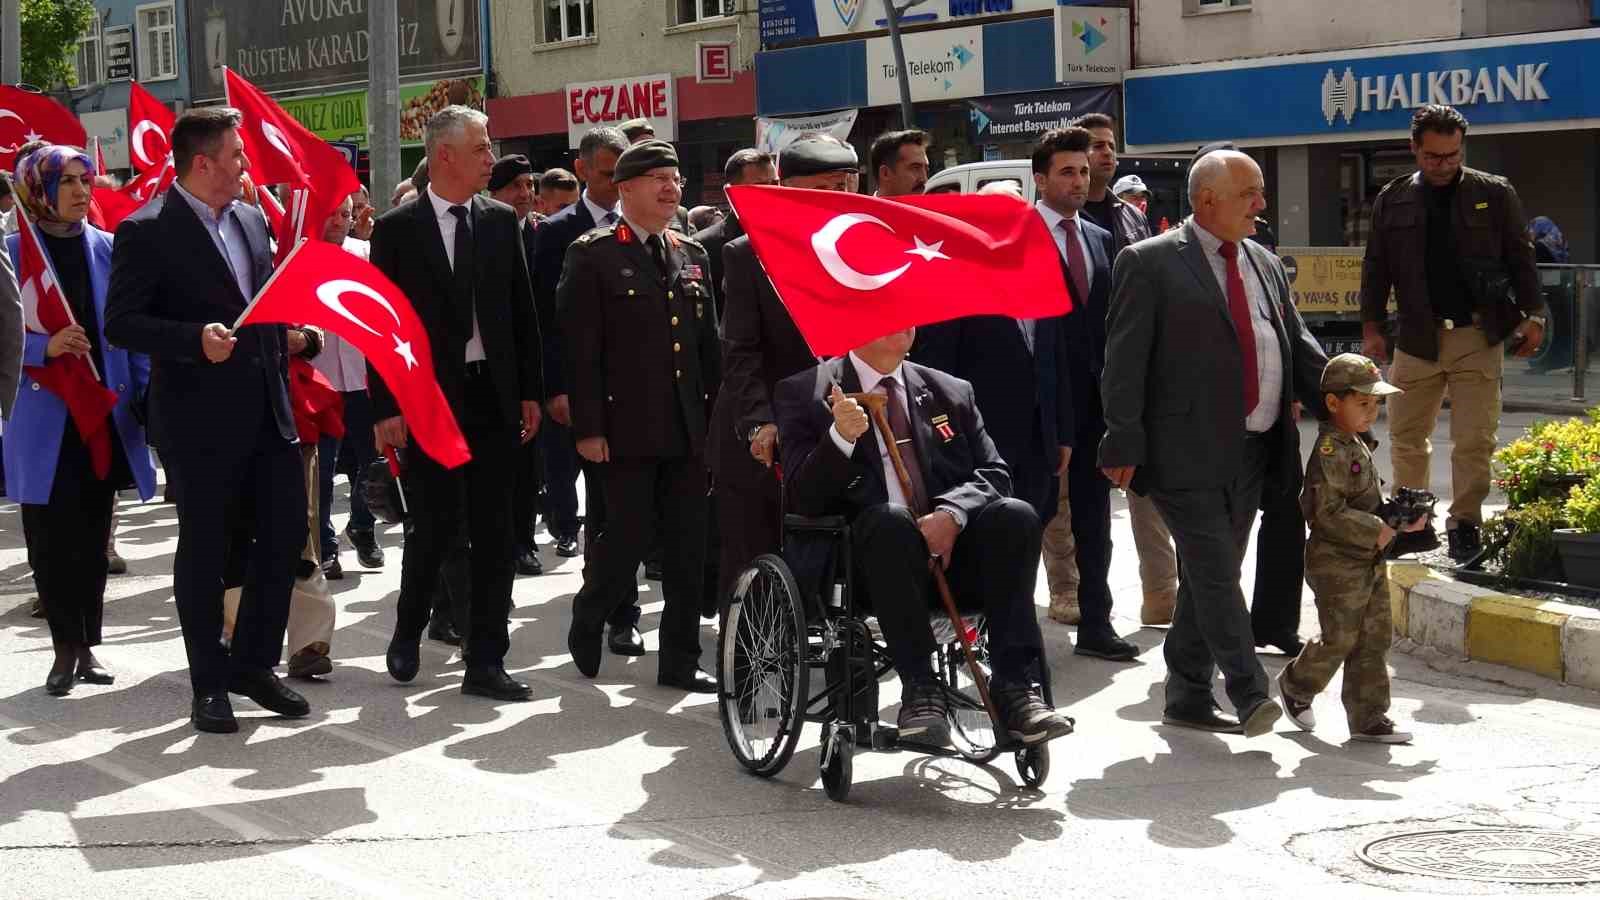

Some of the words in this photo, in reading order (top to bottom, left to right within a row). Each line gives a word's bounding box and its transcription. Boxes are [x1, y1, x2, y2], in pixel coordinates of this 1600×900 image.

[237, 45, 302, 78] RÜSTEM
[306, 17, 420, 69] KARADİZ
[707, 50, 726, 75] E
[908, 60, 954, 76] Telekom
[1067, 63, 1082, 72] Türk
[1085, 63, 1116, 73] Telekom
[1361, 62, 1550, 112] HALKBANK
[569, 79, 668, 125] ECZANE
[1014, 103, 1033, 116] Türk
[1034, 101, 1071, 114] Telekom
[331, 99, 363, 130] GIDA
[990, 120, 1024, 135] İnternet
[1303, 291, 1340, 305] YAVAŞ
